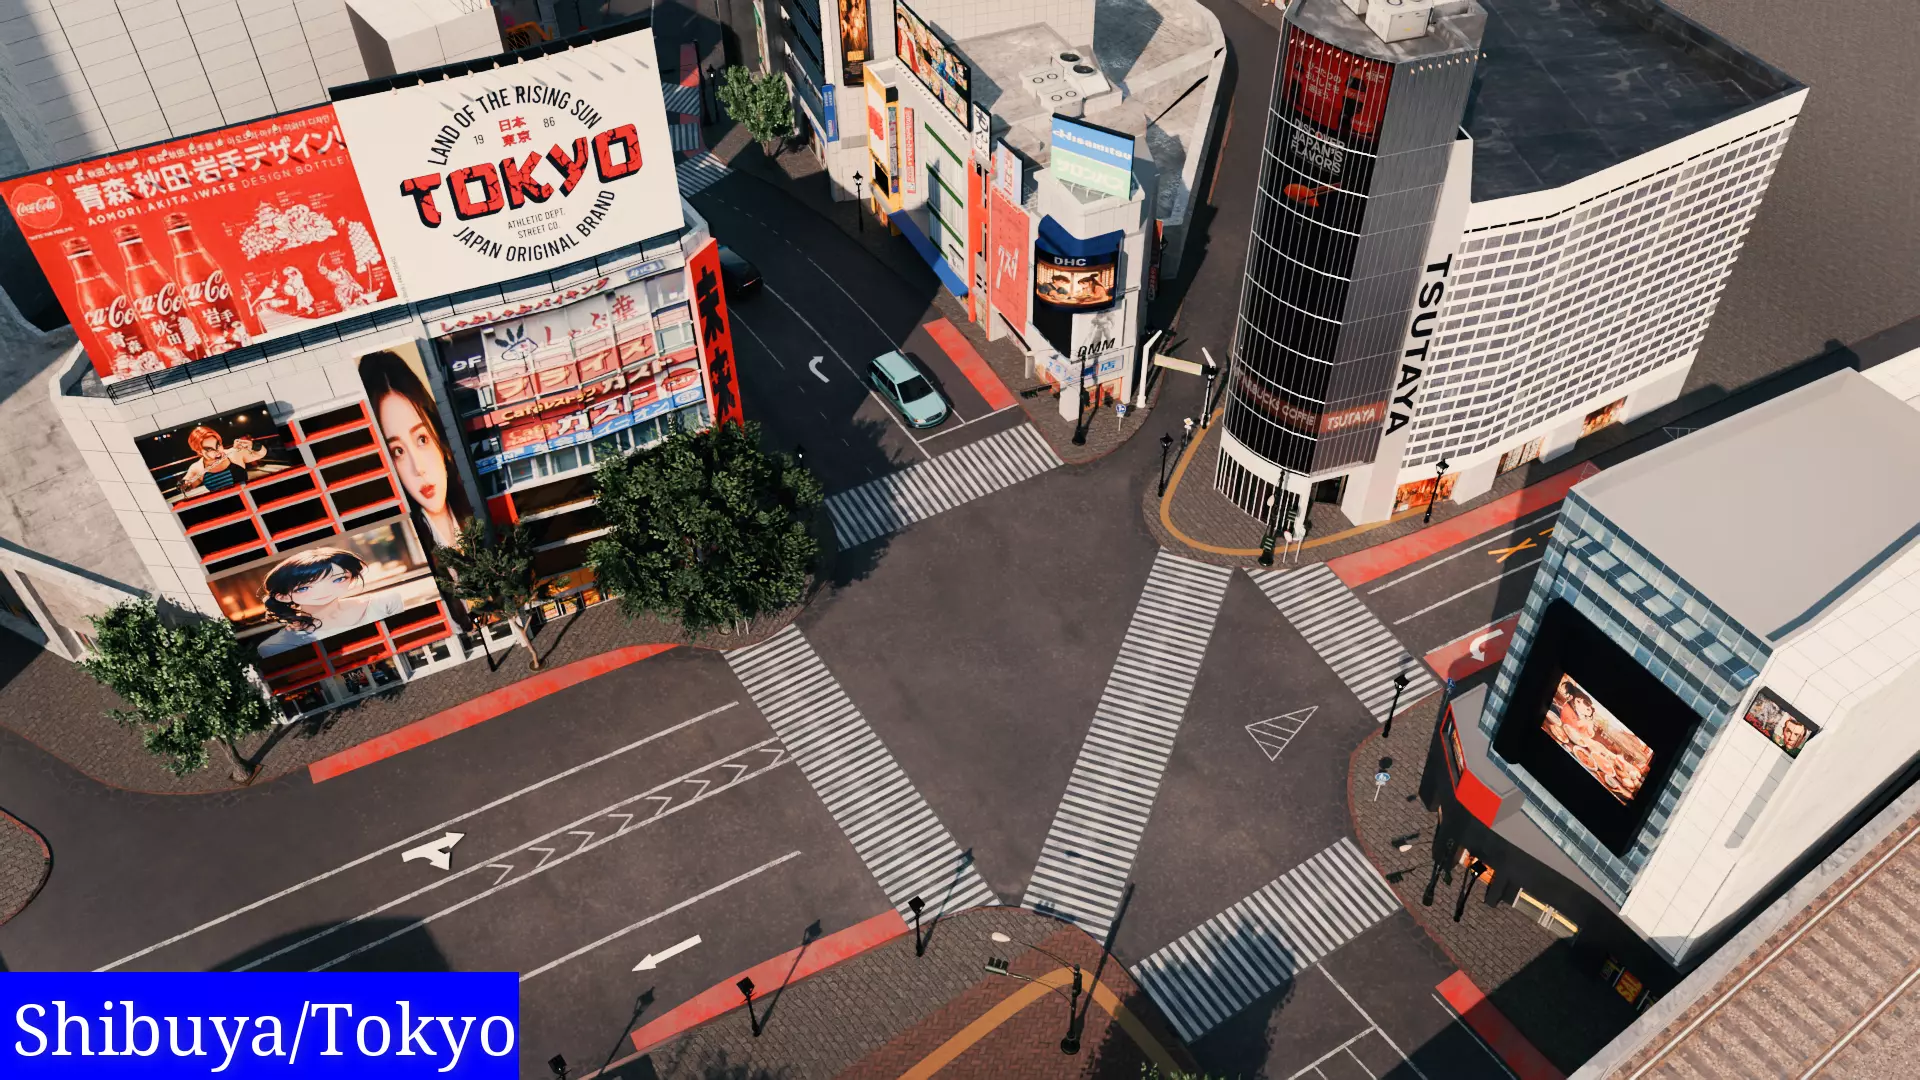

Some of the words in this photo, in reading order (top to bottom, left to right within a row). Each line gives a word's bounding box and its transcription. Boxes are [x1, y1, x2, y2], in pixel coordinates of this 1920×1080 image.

[428, 124, 462, 166] LAND
[453, 104, 477, 129] OF
[475, 88, 512, 115] THE
[515, 85, 571, 110] RISING
[570, 98, 602, 130] SUN
[498, 115, 527, 132] 日本
[543, 116, 556, 128] 86
[1294, 118, 1346, 151] DISCOVER
[473, 133, 485, 145] 19
[501, 129, 532, 148] 東京
[1056, 129, 1132, 160] Hisamitsu
[1292, 130, 1343, 163] JAPAN'S
[1290, 140, 1341, 173] FLAVORS
[241, 170, 293, 189] DESIGN
[399, 123, 643, 229] TOKYO
[452, 226, 504, 259] JAPAN
[505, 233, 580, 262] ORIGINAL
[576, 189, 615, 237] BRAND
[507, 212, 544, 230] ATHLETIC
[544, 206, 566, 221] DEPT.
[517, 223, 547, 239] STREET
[547, 221, 561, 233] CO.
[1053, 256, 1087, 267] DHC
[1384, 253, 1453, 437] TSUTAYA
[602, 357, 673, 394] ガスト
[557, 391, 649, 436] ガスト
[1327, 407, 1376, 431] TSUTAYA
